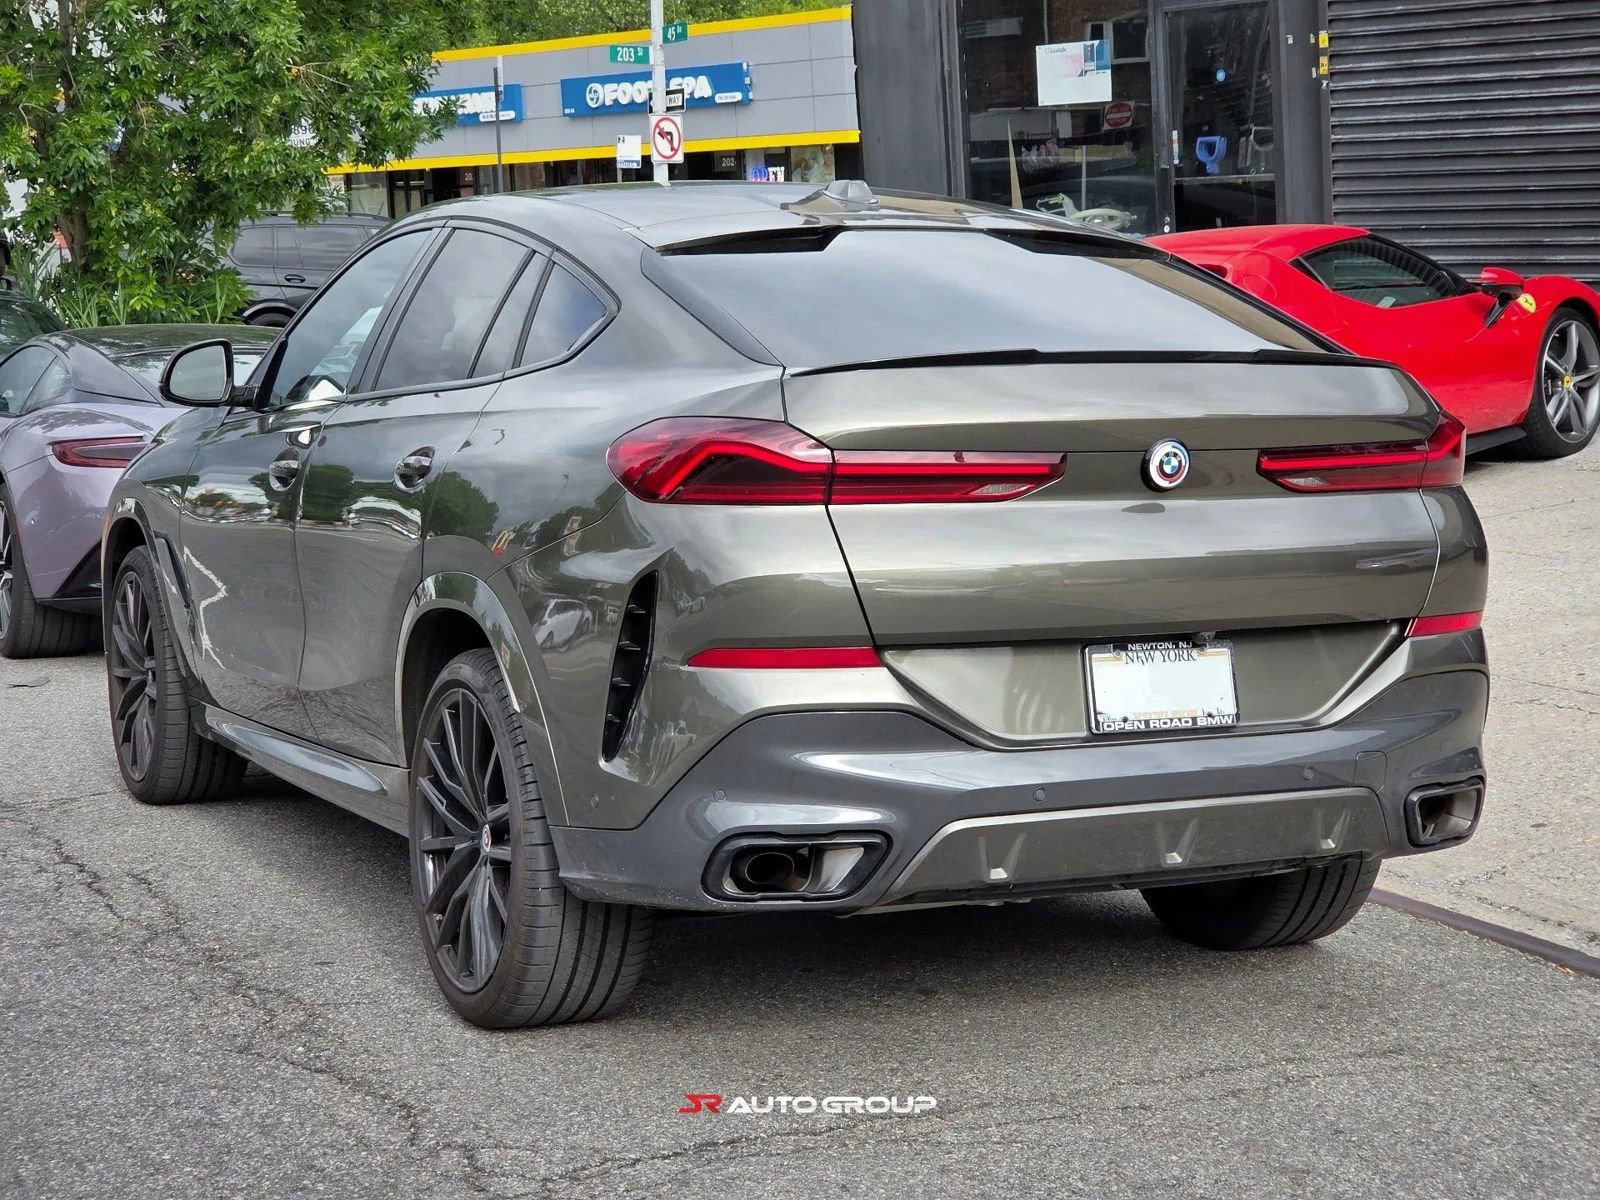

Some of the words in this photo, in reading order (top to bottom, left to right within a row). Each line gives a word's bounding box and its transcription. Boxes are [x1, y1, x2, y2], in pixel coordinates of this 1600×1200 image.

[667, 27, 676, 41] 45
[617, 47, 635, 62] 203
[637, 47, 644, 57] St
[668, 95, 680, 106] WAY
[1128, 642, 1175, 650] NEWTON,
[1125, 650, 1156, 666] NEW
[1159, 649, 1197, 663] YORK
[1103, 720, 1145, 731] OPEN
[1149, 717, 1192, 729] ROAD
[1196, 714, 1234, 726] BMW
